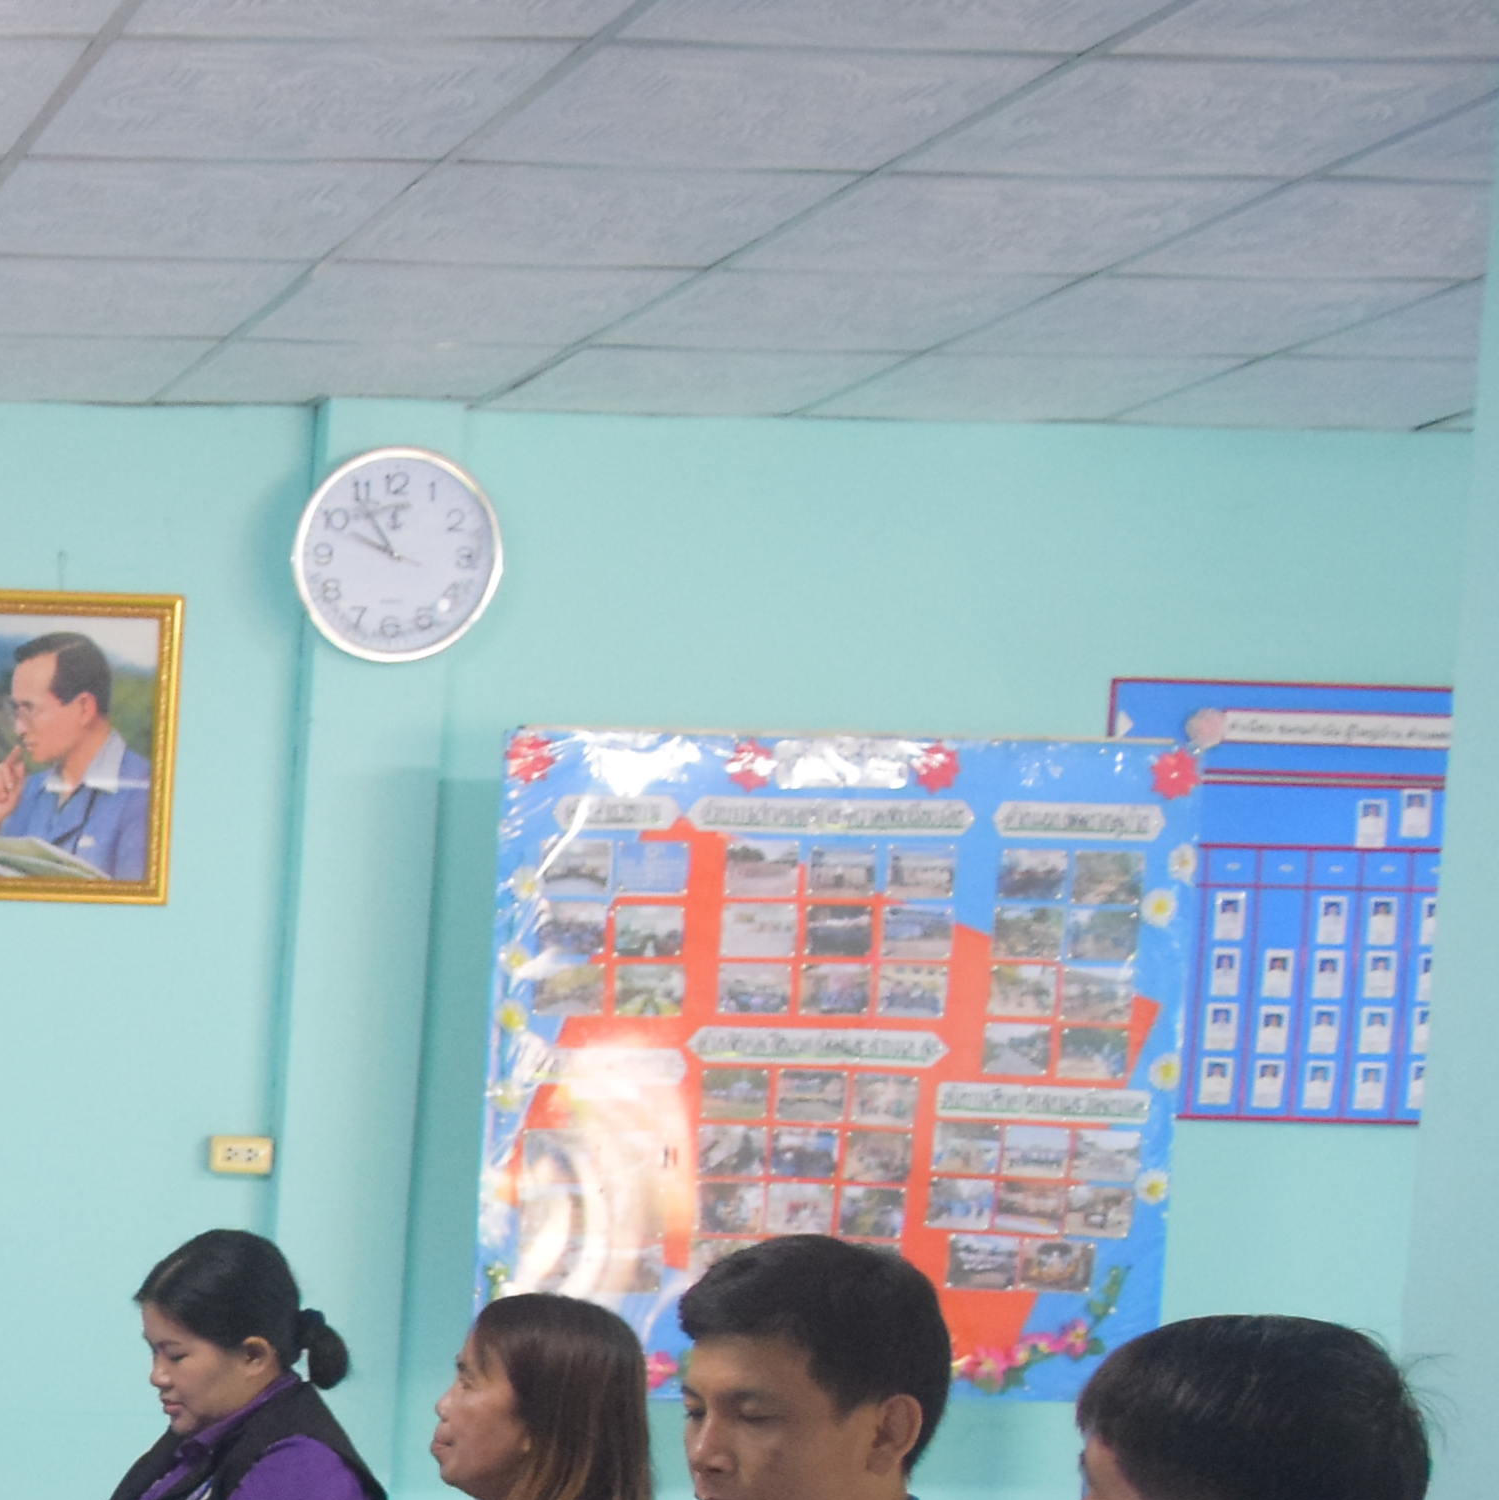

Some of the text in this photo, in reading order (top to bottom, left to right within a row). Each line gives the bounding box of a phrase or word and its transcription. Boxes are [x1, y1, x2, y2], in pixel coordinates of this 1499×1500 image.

[353, 481, 371, 502] 11
[385, 472, 411, 495] 12
[428, 481, 437, 502] 1
[323, 507, 350, 532] 10
[446, 508, 466, 532] 2
[313, 542, 334, 566] 9
[321, 577, 342, 603] 8
[350, 605, 368, 630] 7
[379, 615, 401, 639] 6
[415, 606, 434, 631] 5
